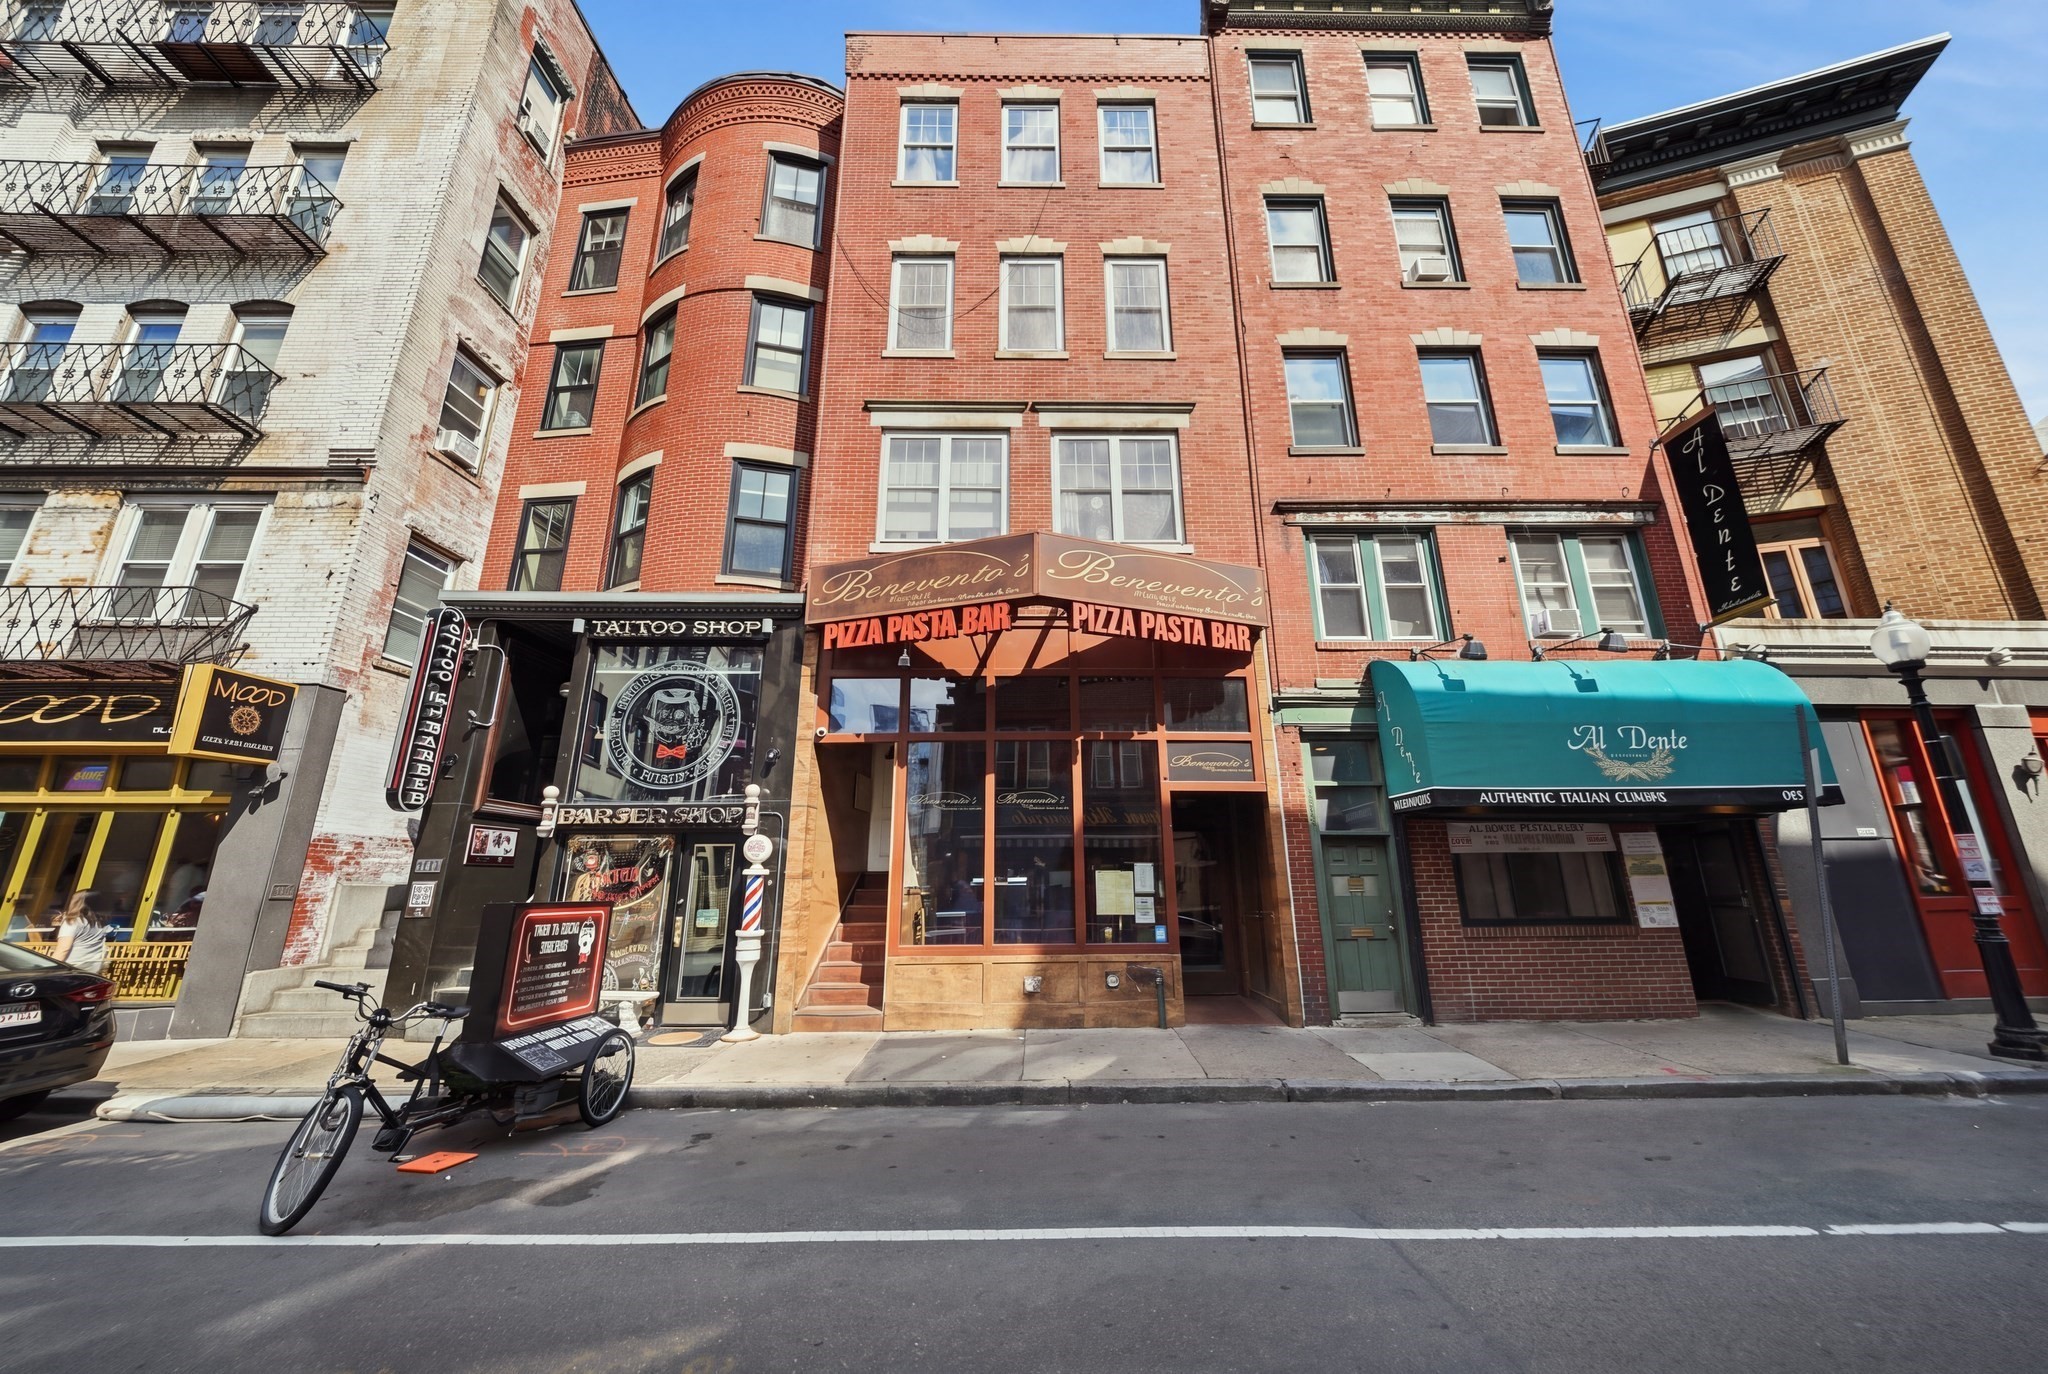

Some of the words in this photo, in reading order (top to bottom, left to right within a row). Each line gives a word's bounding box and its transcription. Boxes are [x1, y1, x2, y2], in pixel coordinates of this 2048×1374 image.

[812, 551, 1030, 606] Benevento's
[1046, 550, 1263, 607] Benevento's
[693, 620, 761, 635] SHOP
[824, 617, 884, 650] PIZZA
[887, 608, 957, 643] PASTA
[962, 601, 1012, 636] BAR
[1072, 602, 1136, 638] PIZZA
[1141, 611, 1206, 646] PASTA
[1211, 622, 1252, 651] BAR
[214, 677, 286, 707] MOOD
[0, 694, 161, 724] OOD
[1567, 725, 1607, 750] Al
[1617, 725, 1688, 750] Dente
[1479, 792, 1556, 804] AUTHENTIC
[1560, 791, 1611, 803] ITALIAN
